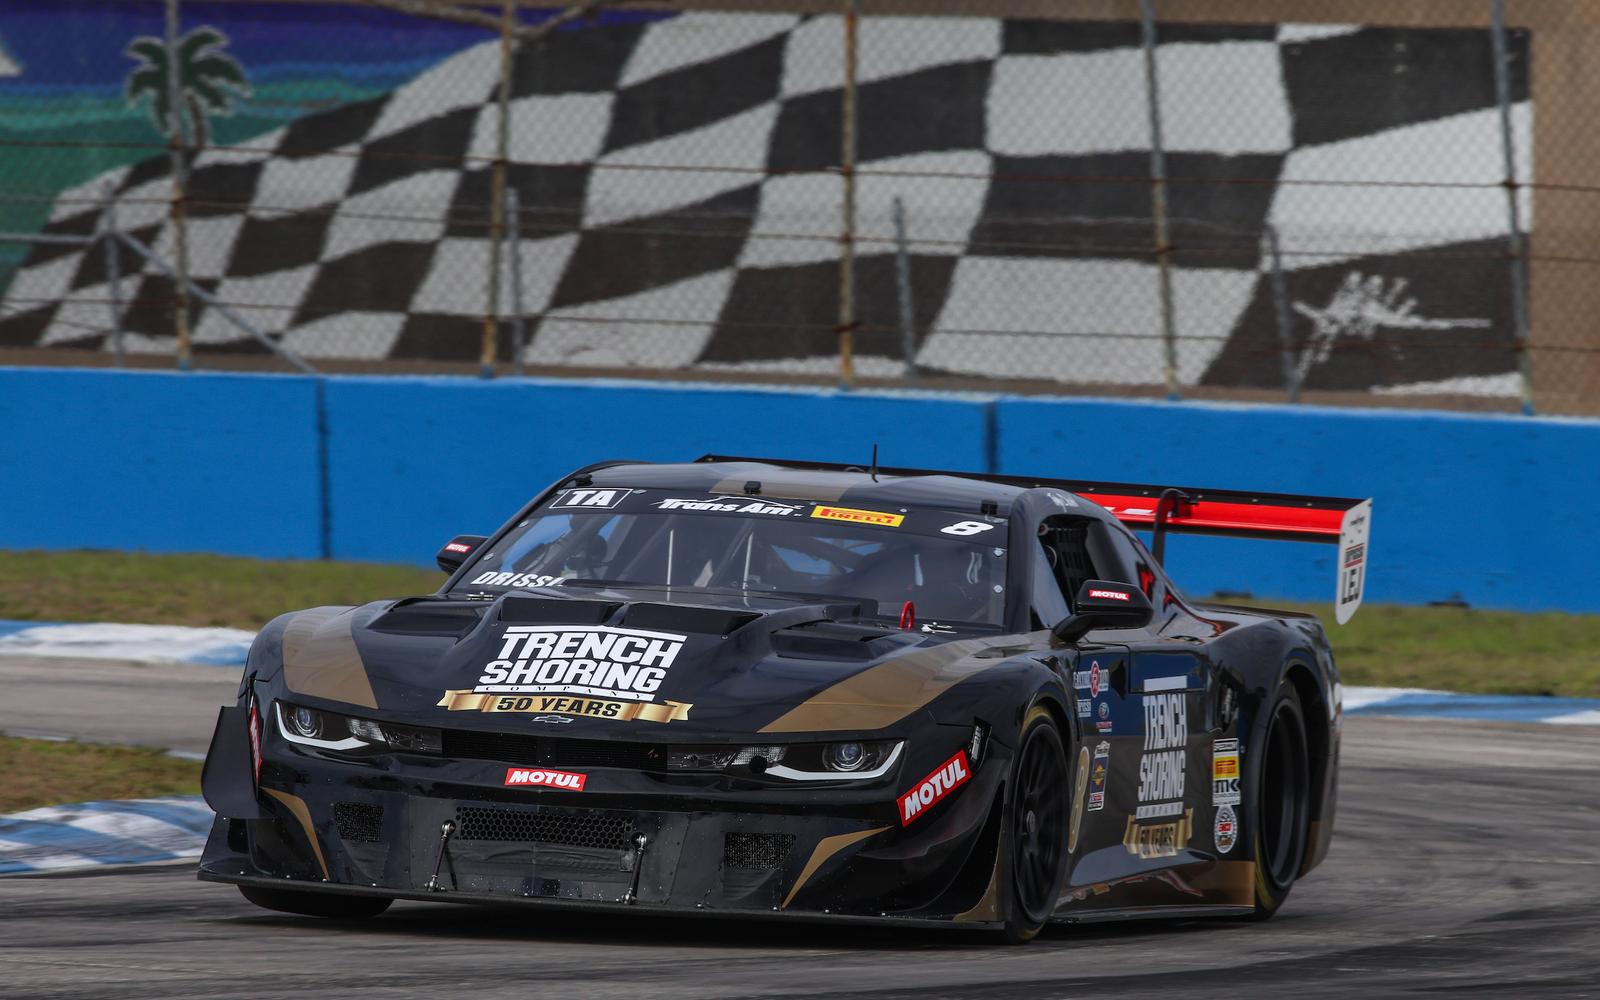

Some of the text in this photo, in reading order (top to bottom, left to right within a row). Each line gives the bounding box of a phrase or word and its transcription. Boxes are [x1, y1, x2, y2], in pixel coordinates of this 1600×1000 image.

[566, 490, 617, 506] TA
[658, 498, 736, 511] Trans
[819, 508, 896, 525] PIRELLI
[940, 520, 994, 536] 8
[1091, 590, 1129, 600] MOTUL
[497, 632, 684, 668] TRENCH
[478, 658, 667, 692] SHORING
[484, 686, 643, 698] COMPANY
[497, 697, 622, 717] 50 YEARS
[1142, 693, 1187, 751] TRENCH
[507, 770, 581, 789] MOTUL
[1138, 750, 1186, 802] SHORING
[904, 758, 966, 821] MOTUL
[1068, 746, 1089, 853] 8
